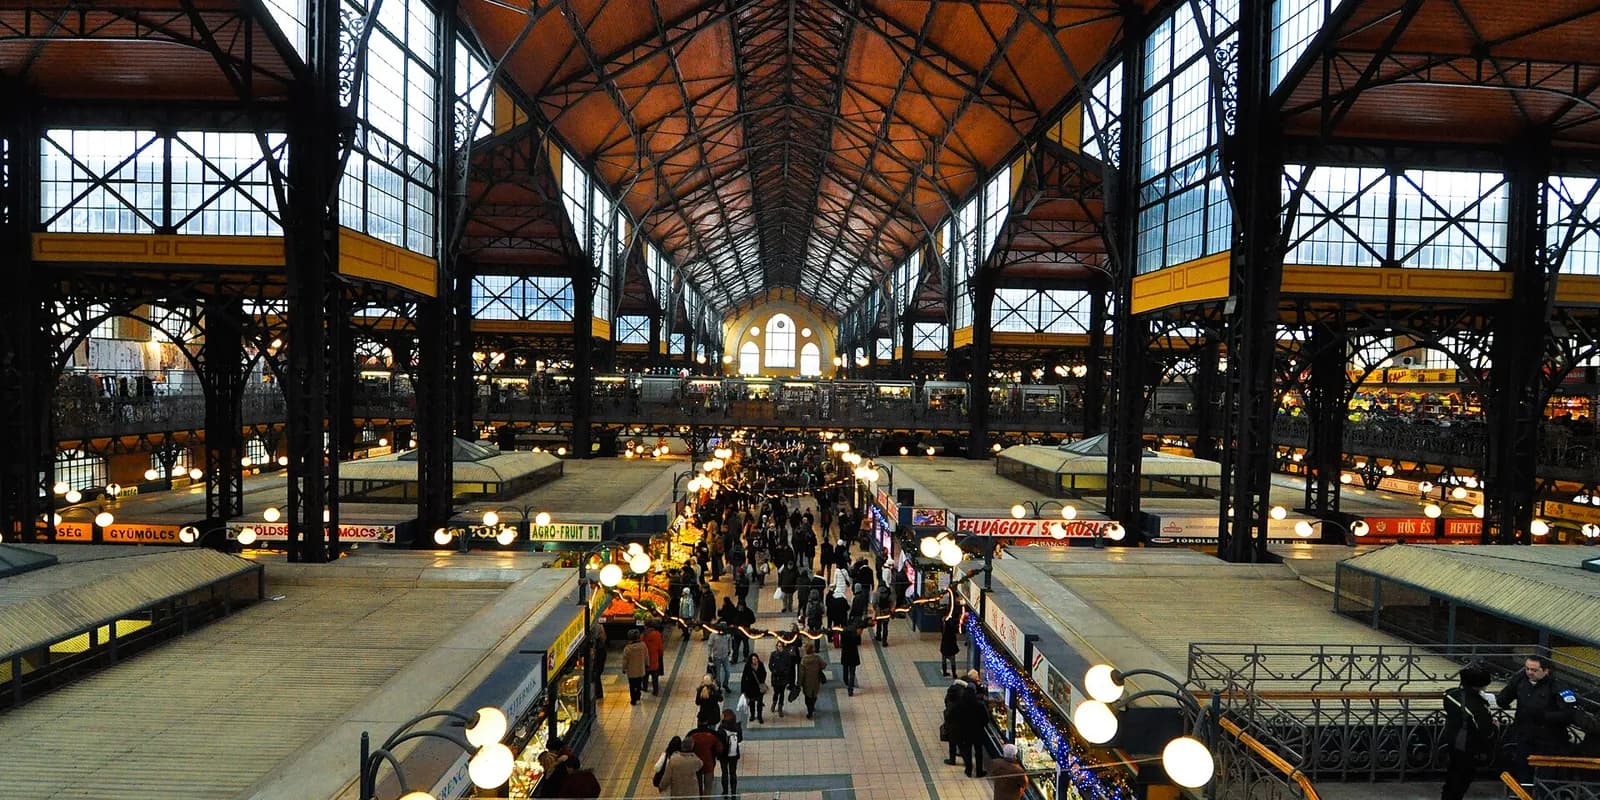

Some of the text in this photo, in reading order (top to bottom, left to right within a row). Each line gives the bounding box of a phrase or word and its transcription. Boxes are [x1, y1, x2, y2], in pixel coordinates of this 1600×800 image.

[56, 525, 82, 537] SÉG
[110, 526, 175, 540] GYÜMÖLCS
[532, 524, 601, 540] AGRO-FRUIT BT.
[958, 519, 1112, 537] FELVÁGOTT SKÜZLE
[1397, 519, 1483, 535] HÚS ÉS HENTE
